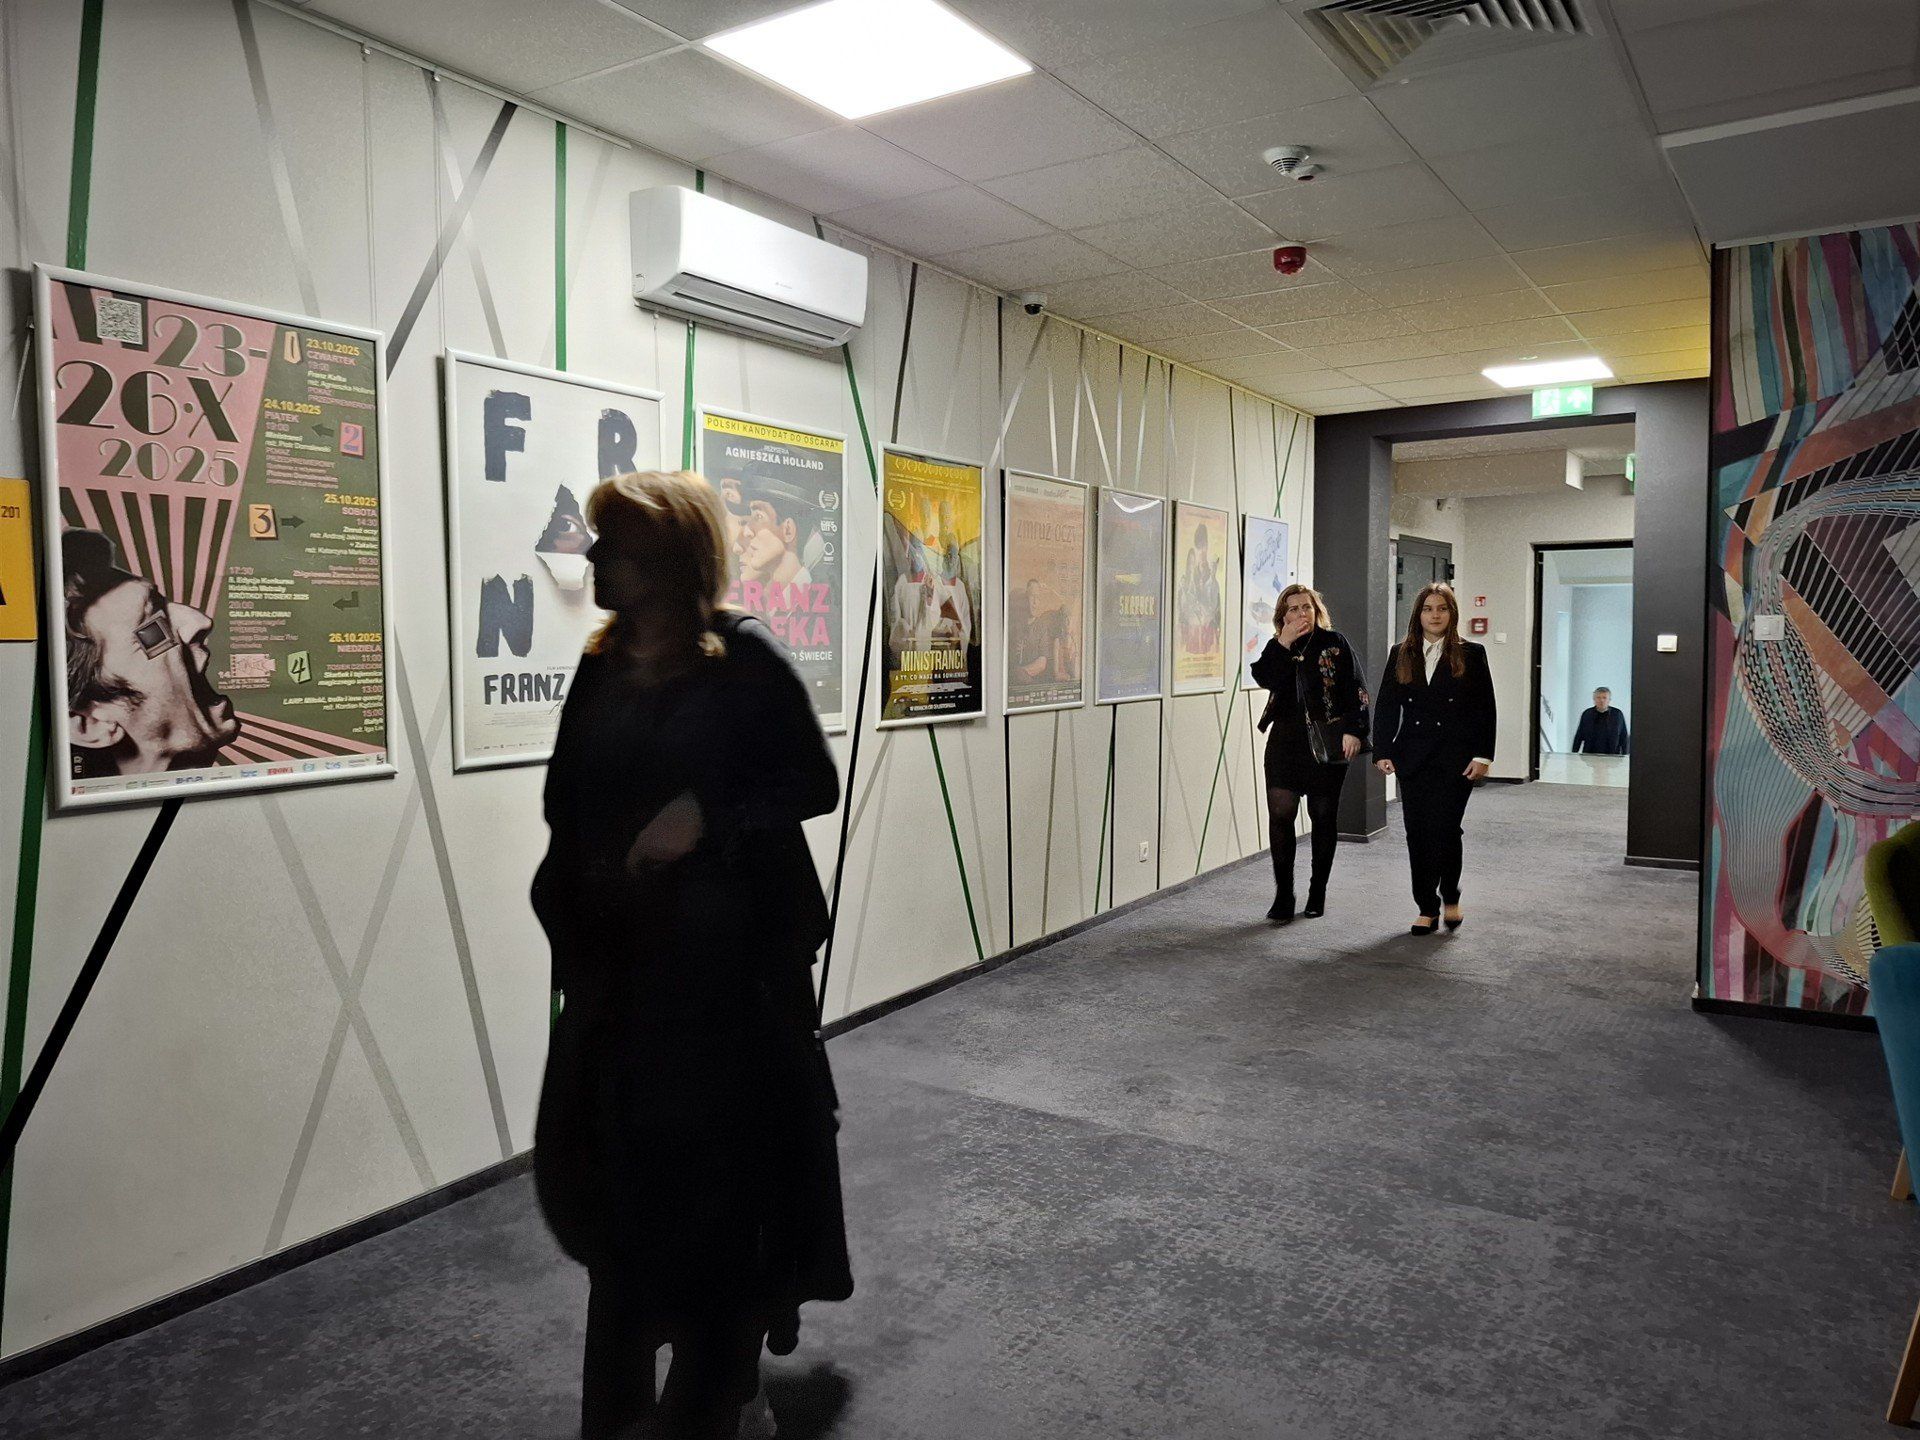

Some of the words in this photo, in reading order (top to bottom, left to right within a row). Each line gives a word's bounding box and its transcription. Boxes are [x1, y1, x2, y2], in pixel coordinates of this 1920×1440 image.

[306, 338, 360, 356] 23.10.2025
[263, 398, 322, 415] 24.10.2025
[344, 425, 359, 452] 2
[484, 390, 532, 482] F
[598, 408, 638, 481] R
[707, 417, 740, 431] POLSKI
[743, 424, 788, 440] KANDYDAT
[789, 433, 801, 441] DO
[99, 438, 239, 488] 2025
[725, 446, 781, 465] AGNIESZKA
[783, 455, 824, 471] HOLLAND
[323, 493, 378, 507] 25.10.2025
[341, 506, 377, 517] SOBOTA
[253, 507, 272, 534] 3
[476, 573, 534, 658] N
[328, 632, 382, 643] 26.10.2025
[337, 644, 382, 653] NIEDZIELA
[799, 649, 833, 662] ŚWIECIE
[900, 649, 964, 672] MINISTRANCI
[291, 656, 306, 682] 4
[483, 673, 566, 705] FRANZ
